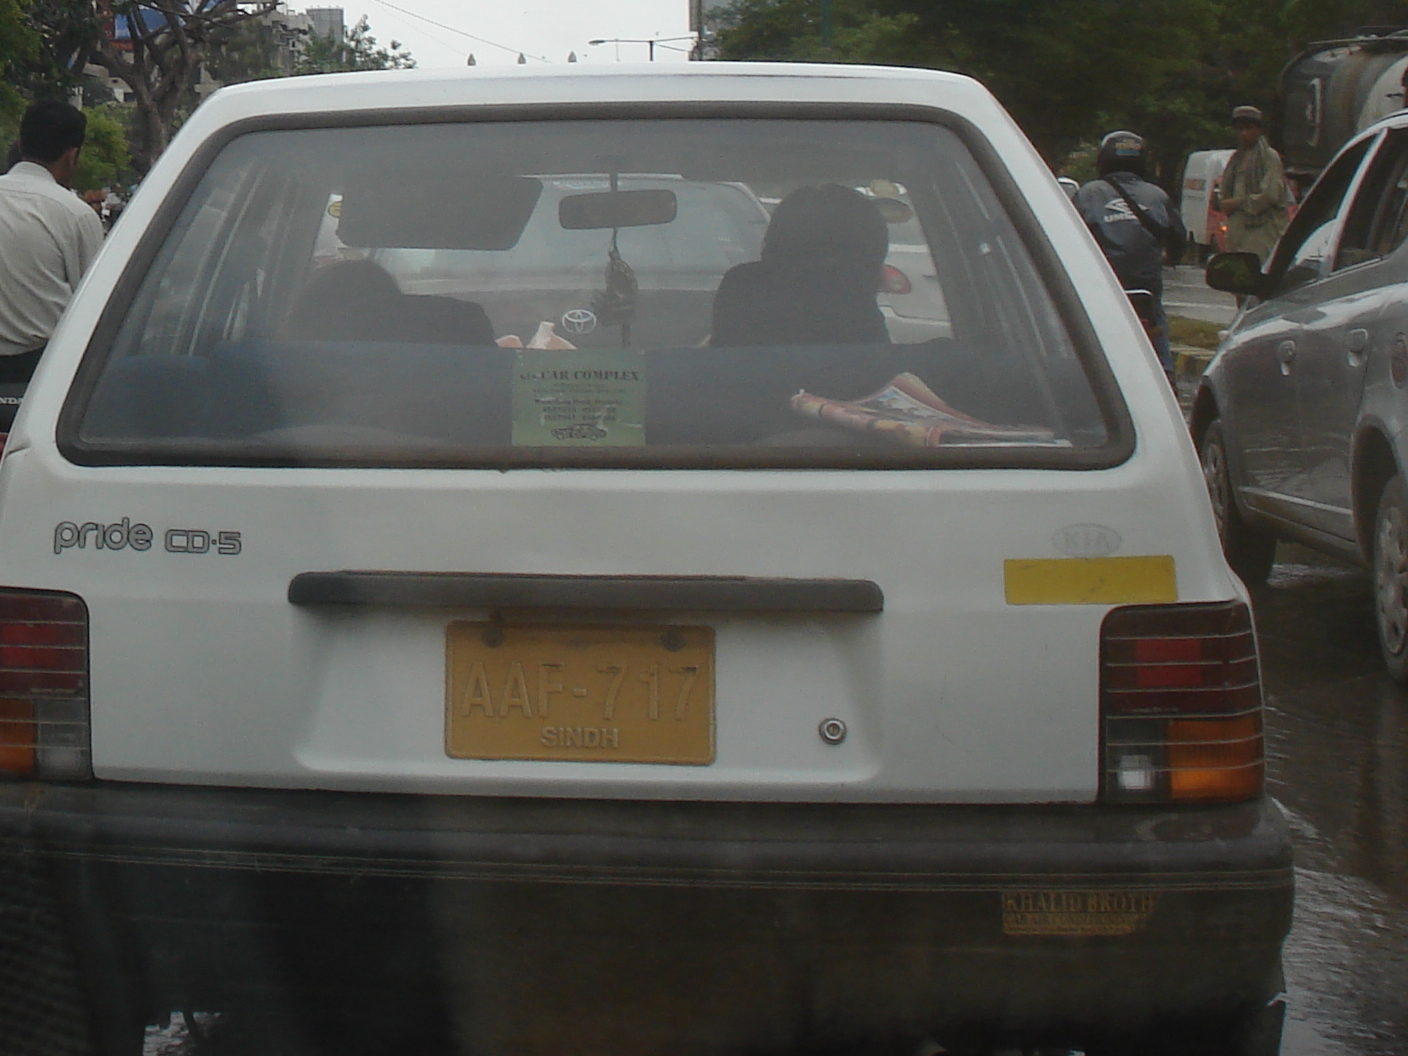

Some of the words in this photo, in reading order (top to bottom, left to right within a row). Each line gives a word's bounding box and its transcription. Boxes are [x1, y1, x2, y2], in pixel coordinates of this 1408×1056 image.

[574, 369, 640, 381] COMPLEX
[53, 516, 154, 555] pride
[540, 726, 620, 749] SINDH
